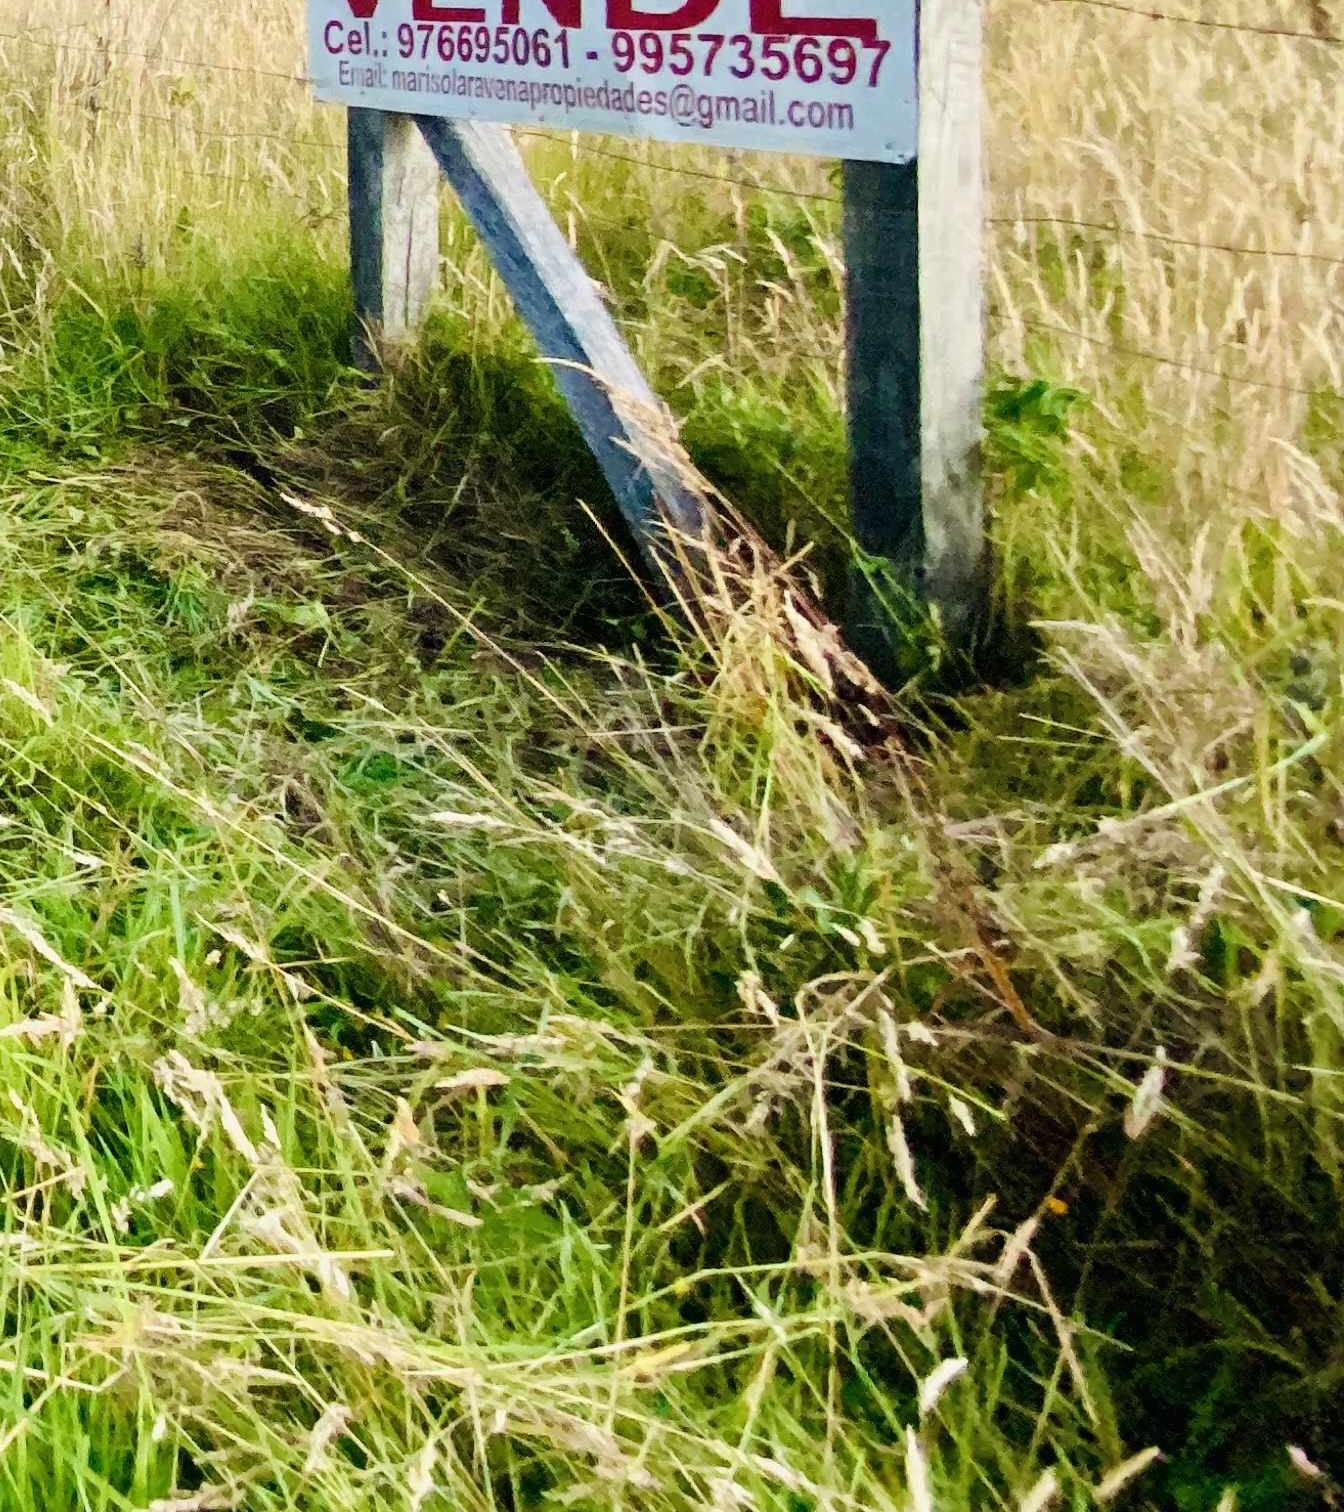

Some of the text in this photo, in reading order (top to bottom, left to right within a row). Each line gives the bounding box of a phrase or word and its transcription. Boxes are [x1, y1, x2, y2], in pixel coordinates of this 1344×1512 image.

[323, 20, 388, 58] Cel.:
[397, 22, 571, 69] 976695061
[611, 30, 892, 88] 995735697
[391, 63, 855, 131] marisolaravenapropiedades@gmail.com
